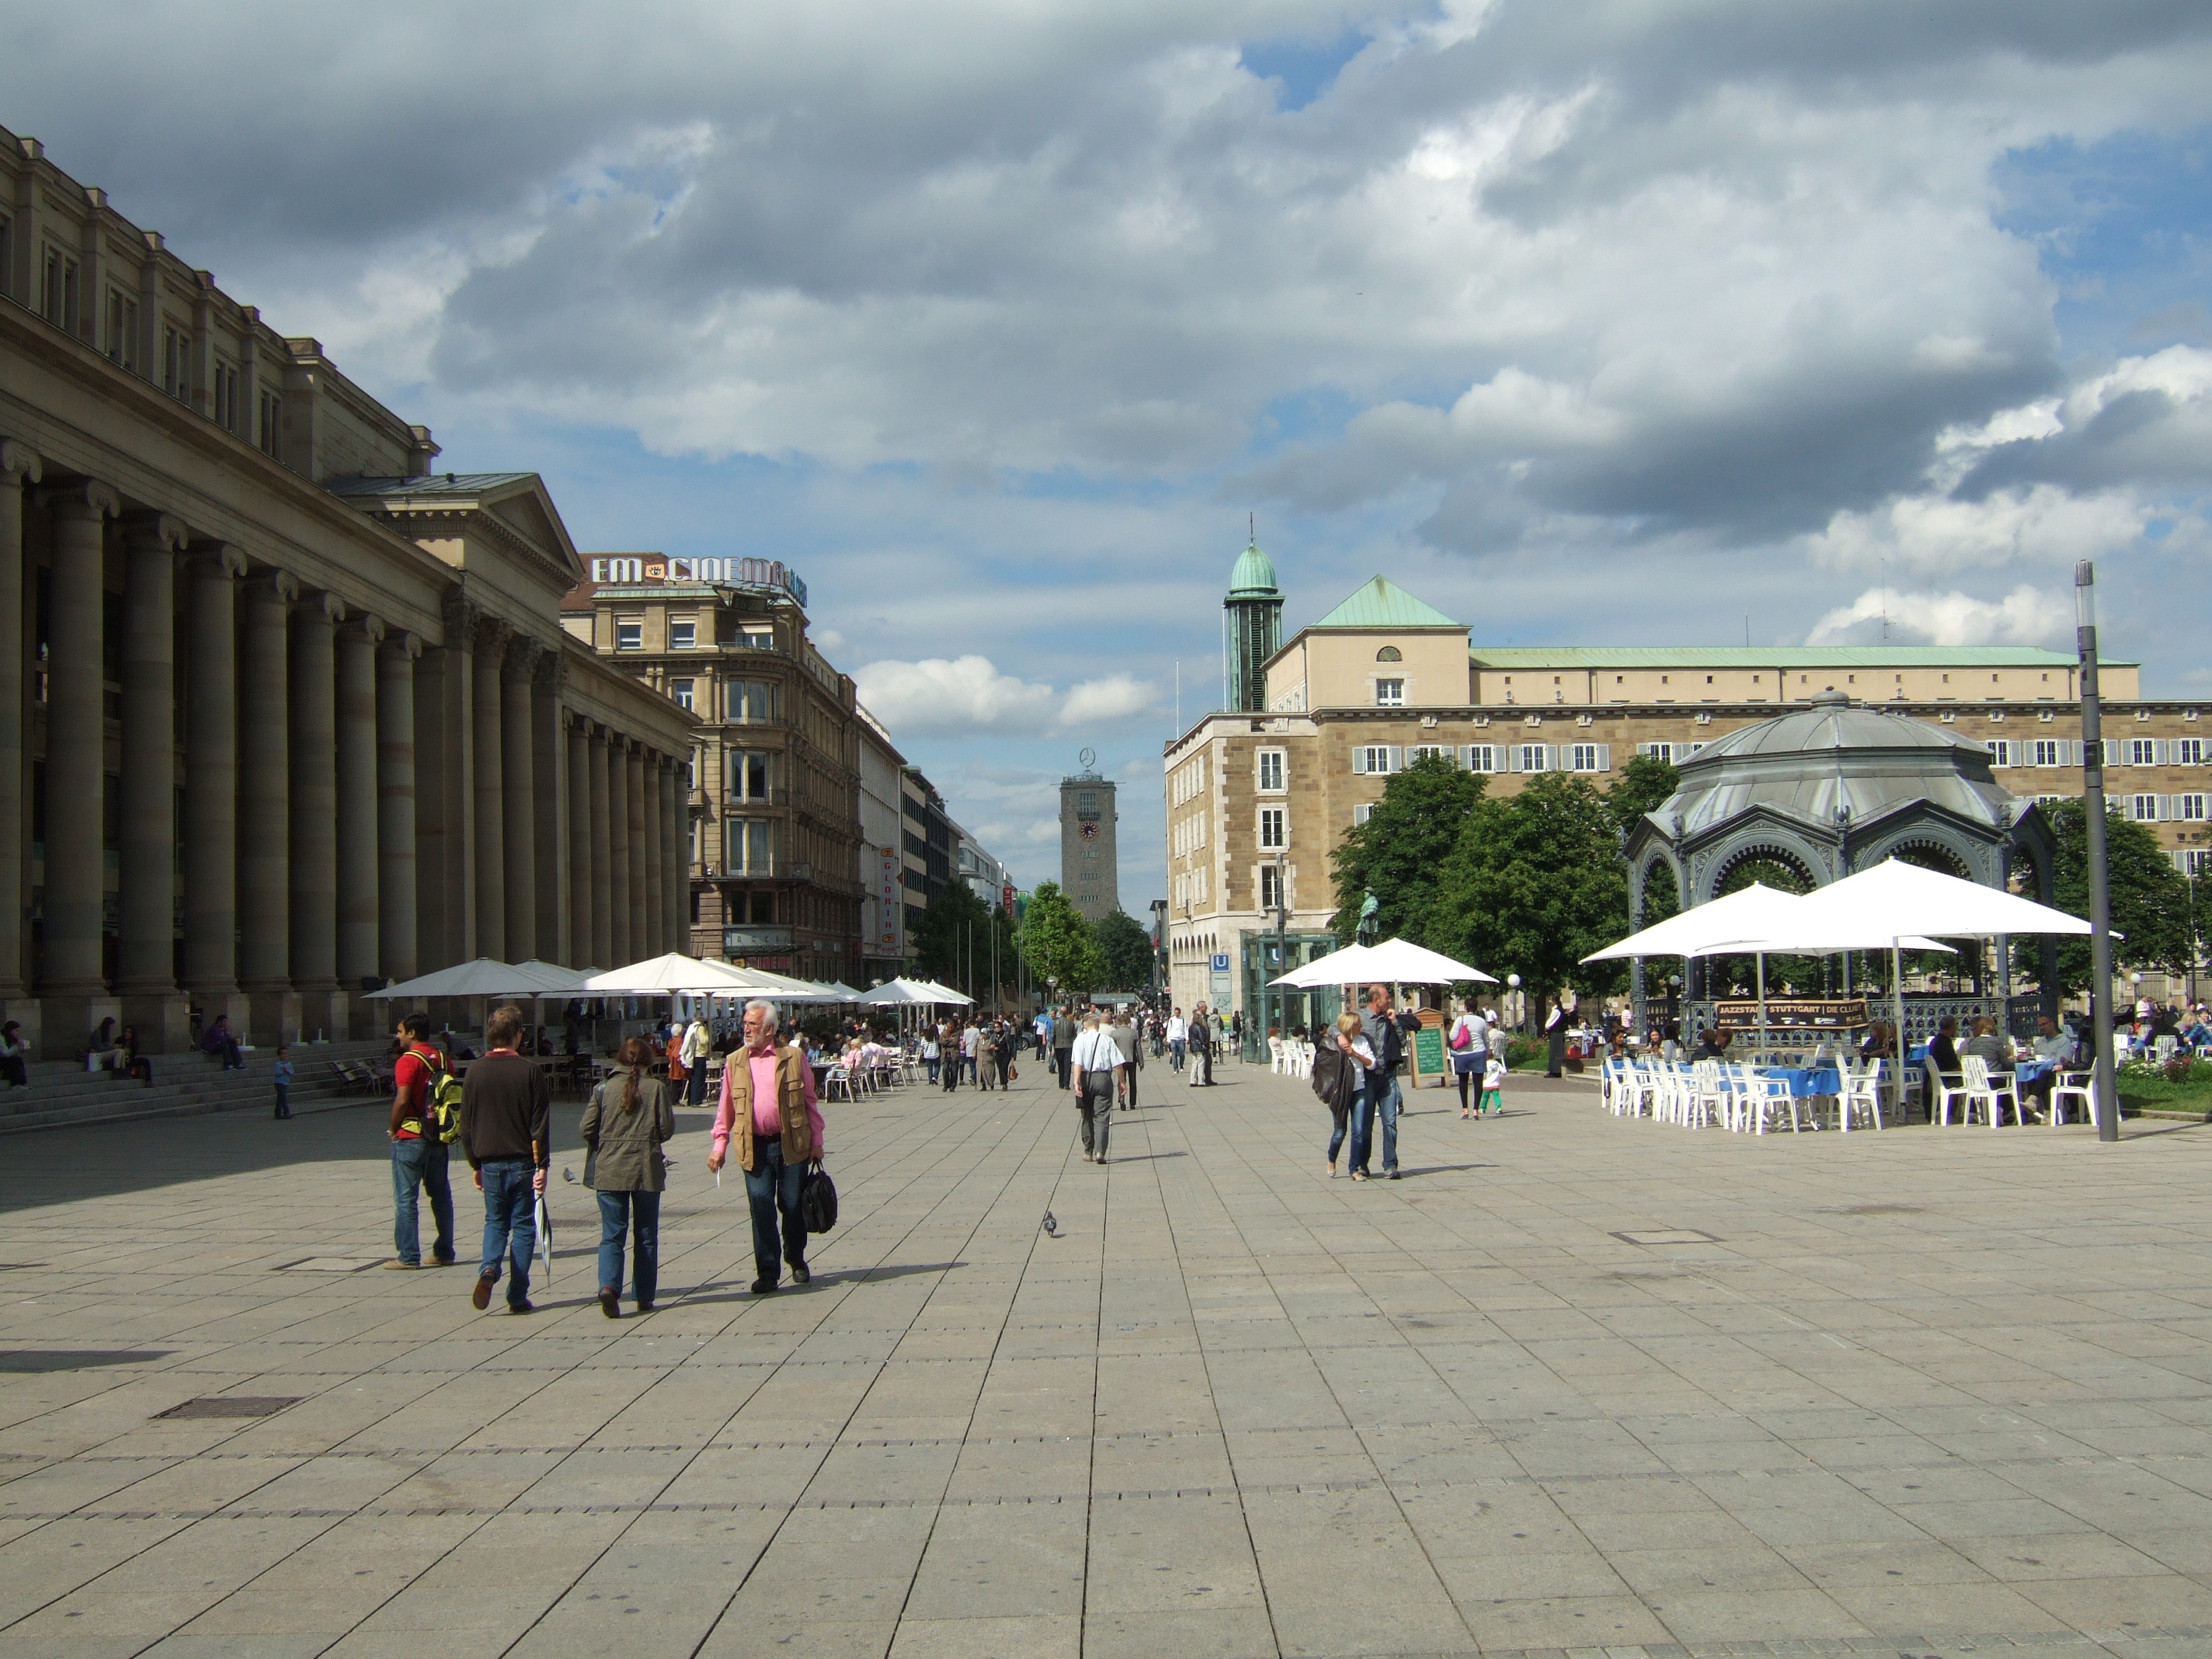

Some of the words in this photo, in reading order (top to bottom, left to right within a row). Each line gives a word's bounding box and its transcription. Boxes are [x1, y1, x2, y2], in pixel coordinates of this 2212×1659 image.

[592, 558, 643, 583] EM
[669, 556, 784, 586] CINEMA
[1216, 955, 1227, 967] U
[1769, 1005, 1821, 1014] STUTTGART
[1840, 1003, 1862, 1014] CLUBS
